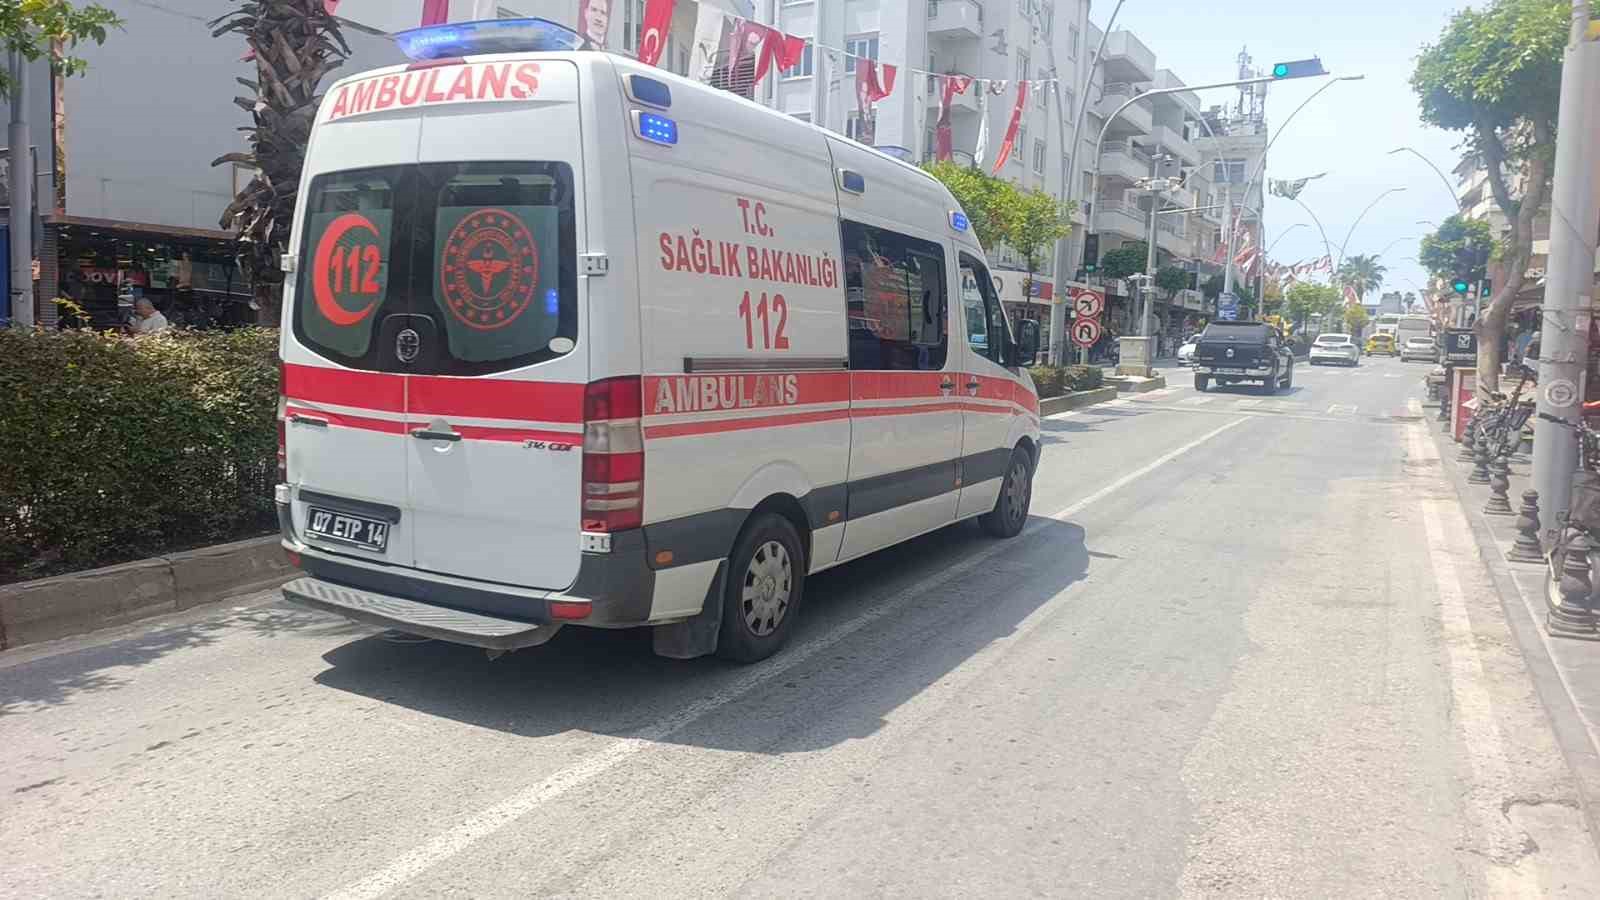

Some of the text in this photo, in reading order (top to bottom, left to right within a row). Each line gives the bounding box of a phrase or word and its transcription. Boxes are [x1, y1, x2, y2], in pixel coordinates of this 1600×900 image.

[329, 63, 541, 120] AMBULANS
[737, 198, 774, 237] T.C.
[331, 244, 383, 294] 112
[659, 227, 838, 289] SAĞLIK BAKANLIĞI
[739, 290, 790, 350] 112
[655, 374, 799, 413] AMBULANS
[312, 511, 385, 546] 07 ETP 14
